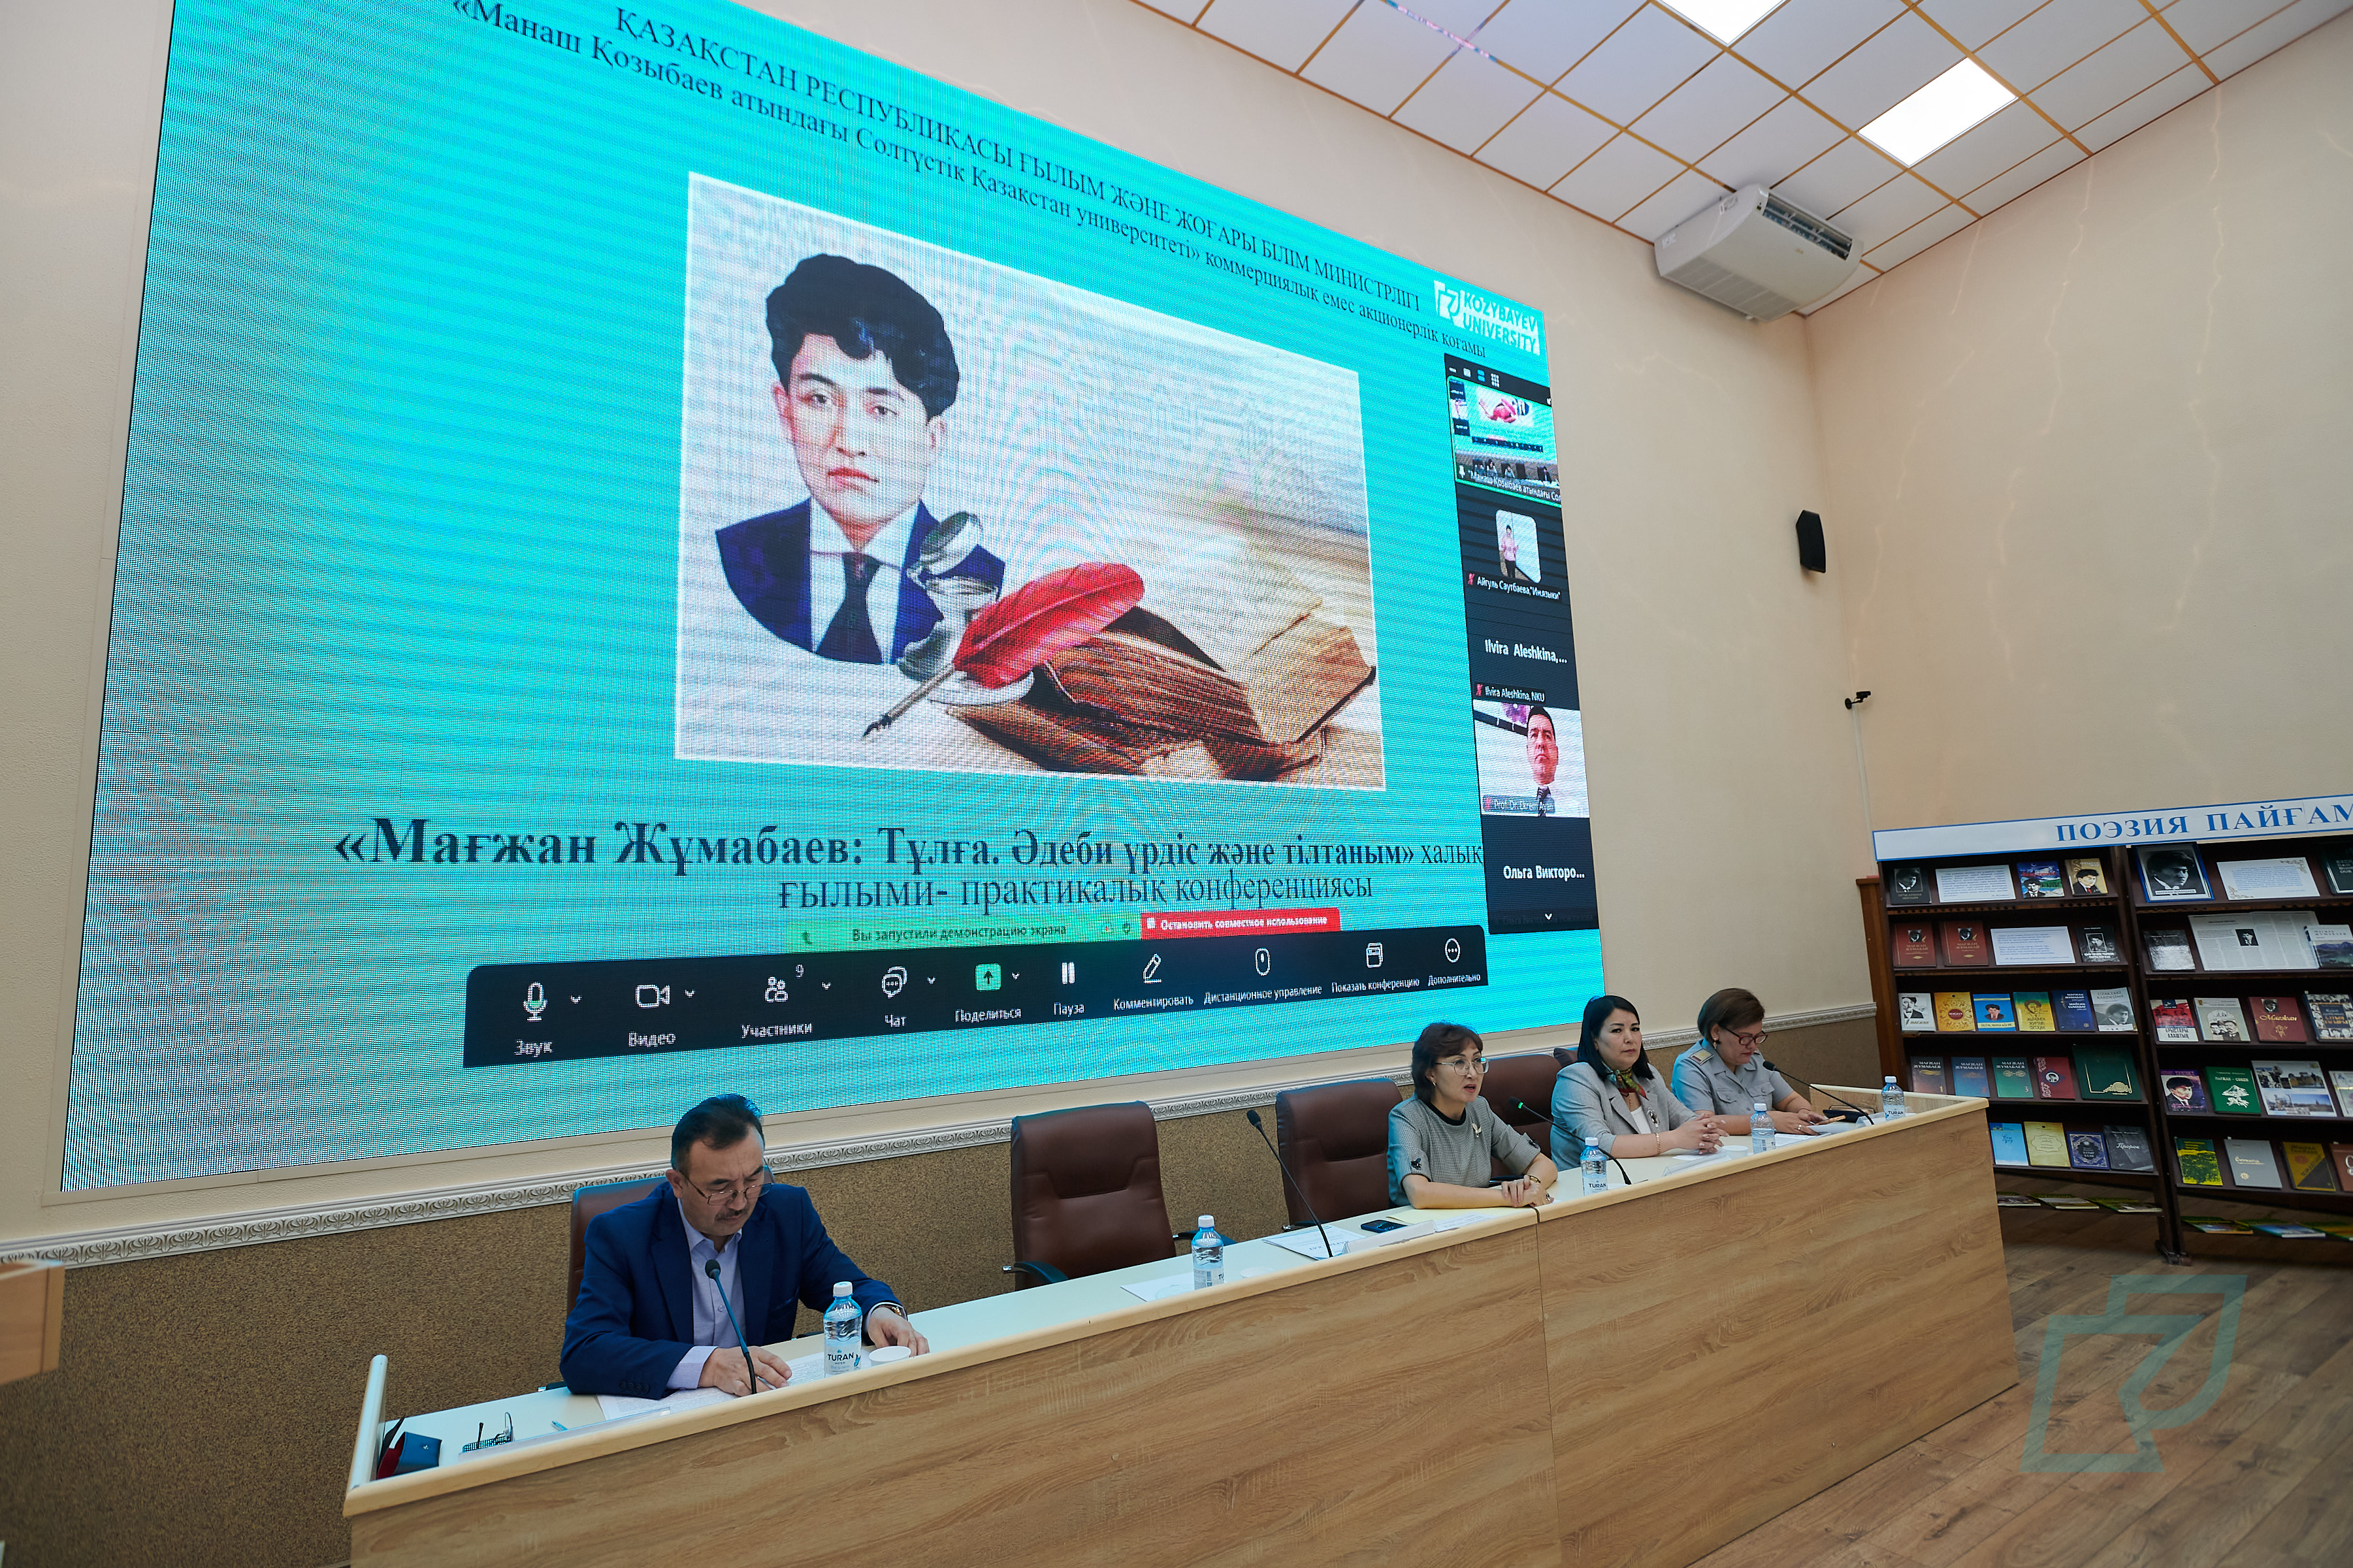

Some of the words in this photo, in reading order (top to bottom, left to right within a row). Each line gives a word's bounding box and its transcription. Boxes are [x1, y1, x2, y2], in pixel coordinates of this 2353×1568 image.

[617, 7, 798, 91] ҚАЗАҚСТАН
[806, 73, 1012, 167] РЕСПУБЛИКАСЫ
[1020, 152, 1105, 200] ҒЫЛЫМ
[1111, 185, 1171, 224] ЖӘНЕ
[590, 35, 723, 101] Қозыбаев
[731, 89, 848, 143] атындағы
[856, 127, 965, 182] Солтүстік
[1077, 208, 1201, 259] университеті»
[1323, 291, 1355, 313] емес
[1359, 304, 1439, 343] акционерлік
[1464, 291, 1538, 332] KOZYBAYEV
[1463, 311, 1538, 353] UNIVERSITY
[1477, 576, 1499, 590] Айгуль
[1485, 638, 1509, 655] Ilvira
[1514, 643, 1568, 664] Aleshkina,...
[2056, 816, 2190, 842] ПОЭЗИЯ
[335, 817, 596, 863] «Мағжан
[614, 821, 862, 877] Жұмабаев:
[878, 827, 999, 875] Тұлға.
[1012, 829, 1112, 867] Әдеби
[1124, 832, 1198, 874] үрдіс
[1208, 841, 1275, 865] және
[1283, 835, 1414, 864] тілтаным»
[1503, 864, 1534, 881] Ольга
[1535, 863, 1585, 882] Викторо...
[960, 879, 1167, 916] практикалық
[1175, 869, 1372, 910] конференциясы
[1160, 920, 1214, 931] Остановить
[1214, 917, 1265, 929] совместное
[1265, 916, 1328, 927] использование
[852, 927, 872, 942] Вы
[875, 927, 937, 944] запустили
[939, 925, 1027, 942] демонстрацию
[1029, 924, 1067, 938] экрана
[1331, 980, 1367, 995] Показать
[1367, 976, 1421, 993] конференцию
[1427, 972, 1482, 987] Дополнительно
[1113, 995, 1193, 1012] Комментировать
[1203, 988, 1273, 1006] Дистанционное
[1274, 984, 1323, 1001] управление
[954, 1006, 1022, 1025] Поделиться
[1053, 1001, 1085, 1017] Пауза
[884, 1013, 907, 1029] Чат
[628, 1031, 676, 1048] Видео
[741, 1022, 813, 1040] Участники
[514, 1039, 553, 1058] Звук
[827, 1352, 854, 1362] TURAN
